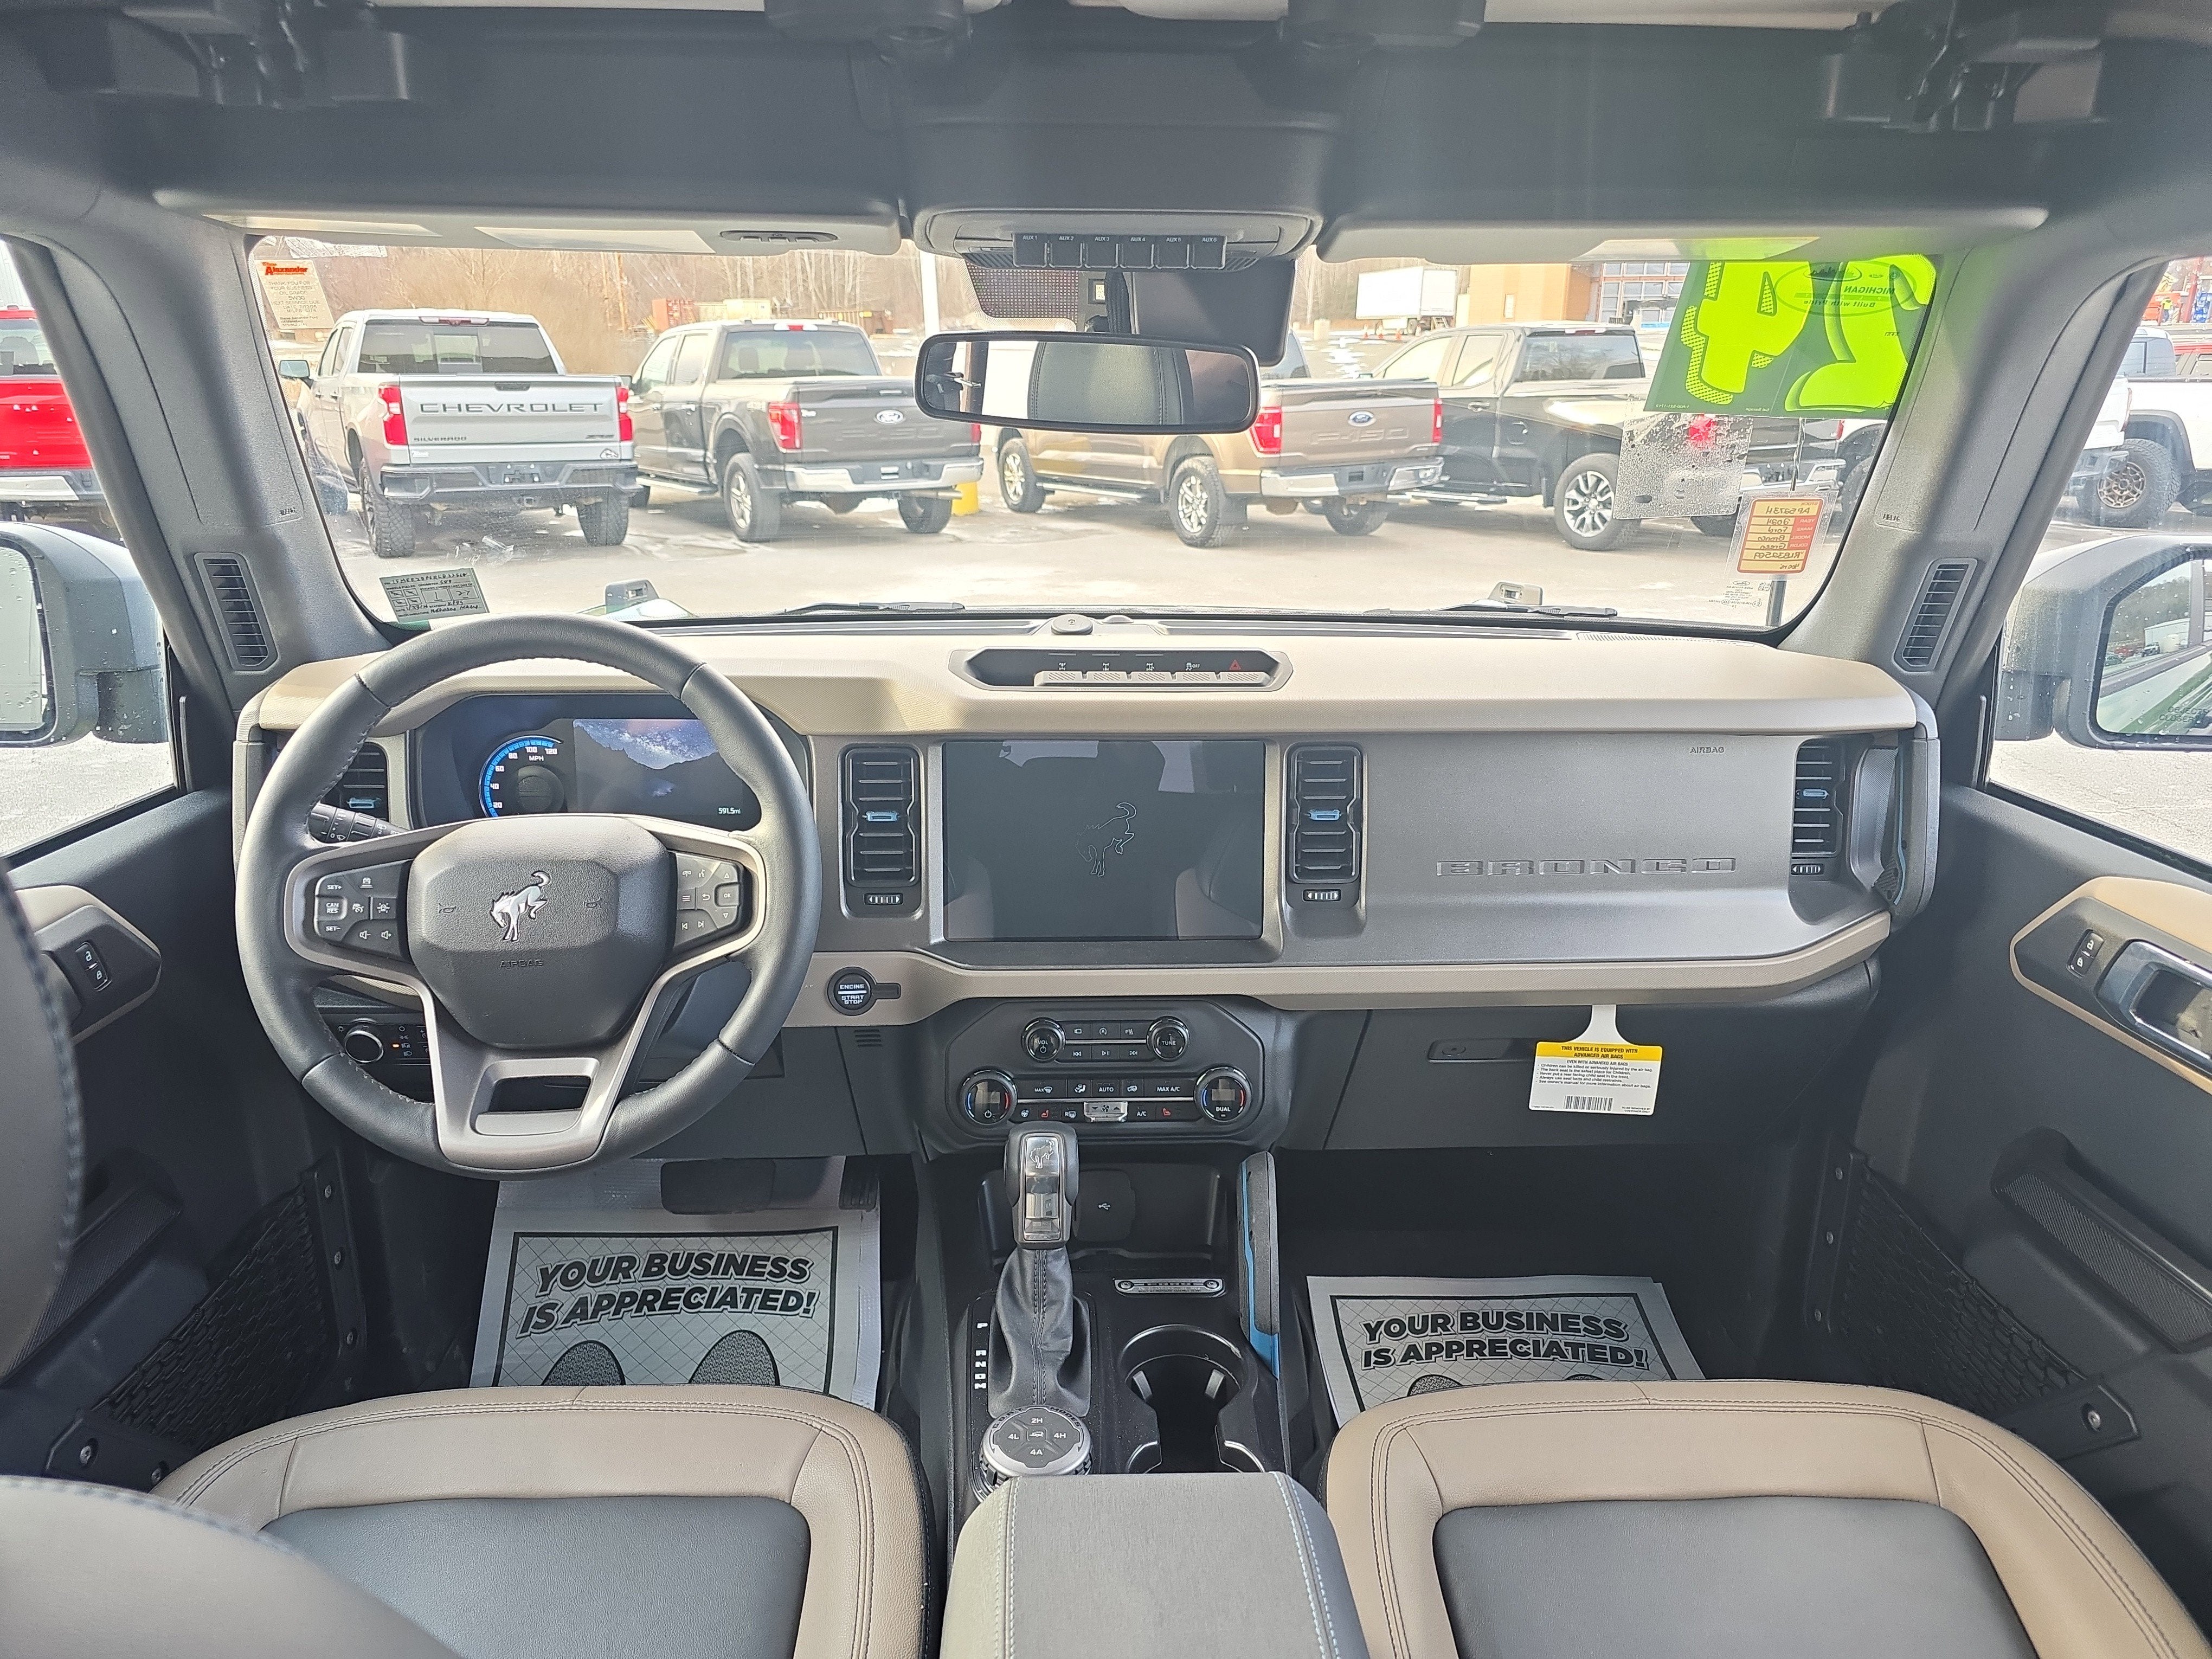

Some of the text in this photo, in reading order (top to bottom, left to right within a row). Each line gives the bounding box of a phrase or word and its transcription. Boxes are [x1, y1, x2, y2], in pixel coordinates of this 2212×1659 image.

[265, 266, 308, 275] Alexander
[420, 403, 604, 414] CHEVROLET
[1311, 427, 1410, 445] F-150
[1689, 746, 1725, 754] AIRBAG
[1436, 858, 1736, 877] BRONCO
[499, 959, 543, 968] AIRBAG
[536, 1251, 813, 1296] YOUR BUSINESS
[517, 1285, 820, 1338] IS APPRECIATED!
[1360, 1310, 1628, 1343] YOUR BUSINESS
[1362, 1336, 1648, 1369] IS APPRECIATED!
[1050, 1407, 1082, 1427] MODES
